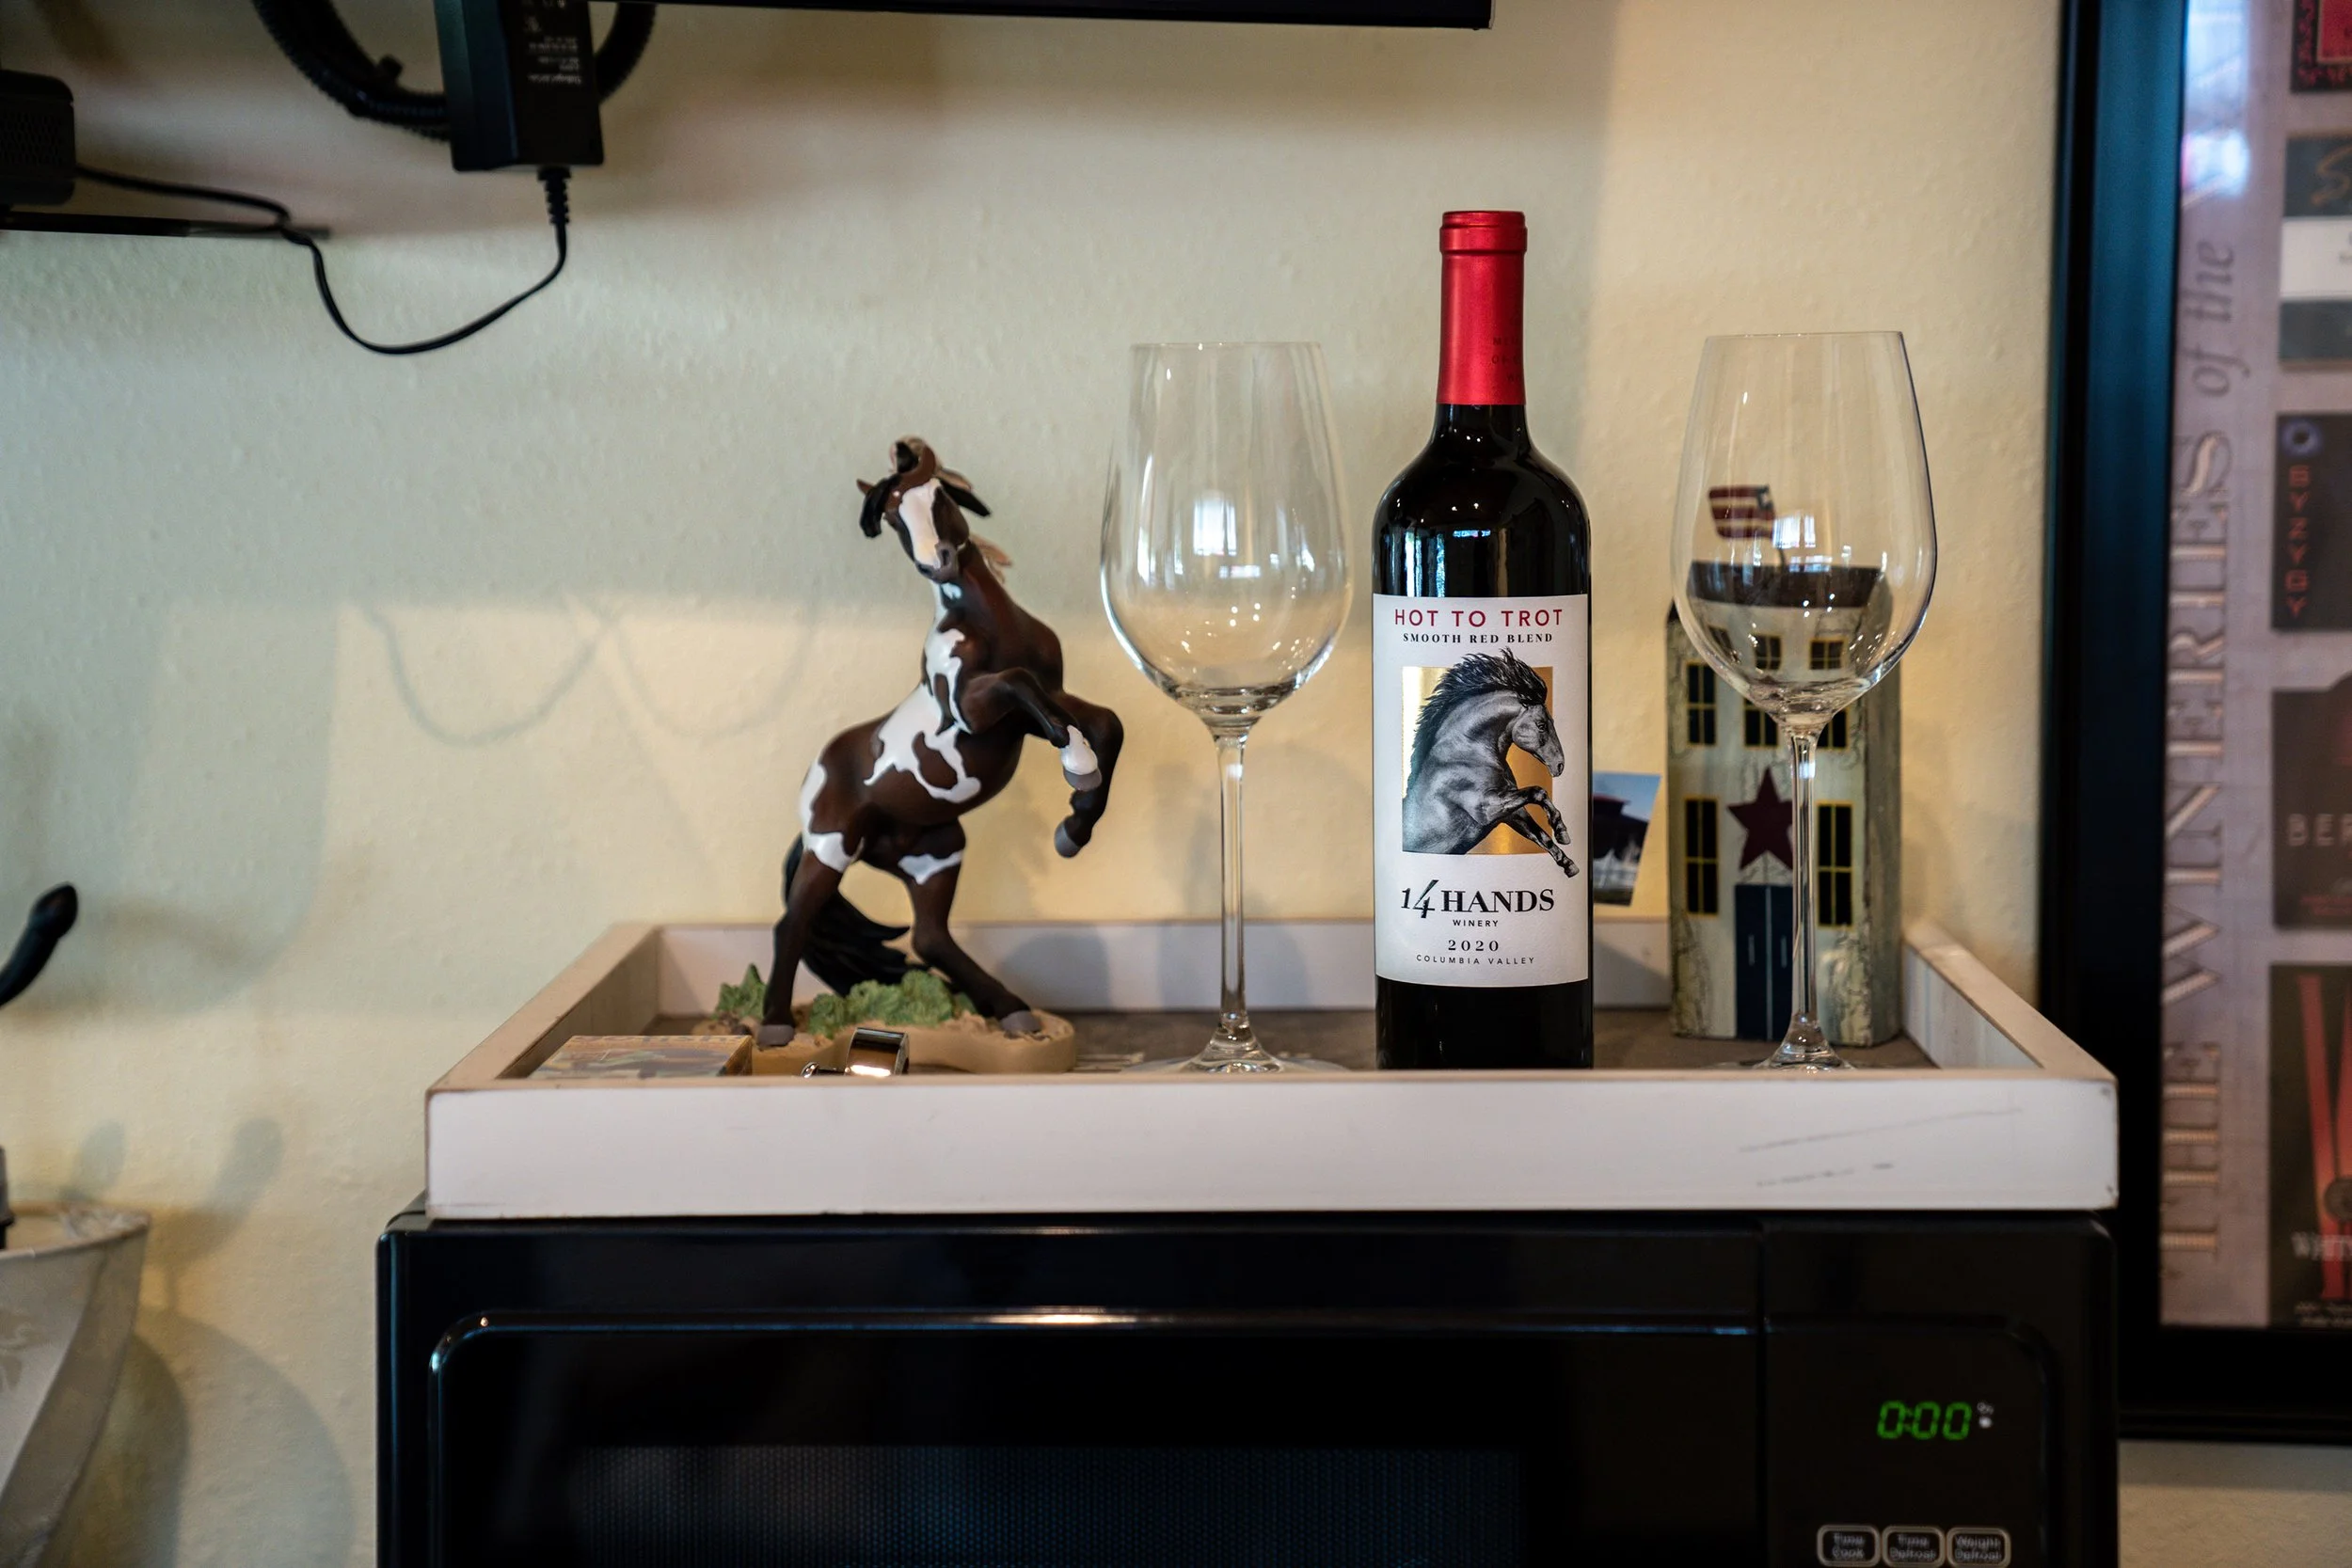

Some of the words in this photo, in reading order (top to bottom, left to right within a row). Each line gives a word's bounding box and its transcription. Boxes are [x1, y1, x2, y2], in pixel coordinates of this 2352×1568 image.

[2178, 239, 2234, 324] the
[2179, 344, 2251, 398] of
[1394, 609, 1438, 626] HOT
[1452, 610, 1486, 628] TO
[1501, 609, 1563, 627] TROT
[1403, 632, 1461, 643] SMOOTH
[1470, 634, 1500, 644] RED
[1507, 633, 1553, 644] BLEND
[2160, 429, 2232, 1003] WINERIES
[1401, 879, 1439, 919] 14
[1440, 888, 1554, 913] HANDS
[1453, 919, 1499, 927] WINERY
[1416, 954, 1480, 965] COLUMBIA
[1488, 957, 1535, 965] VALLEY
[1448, 939, 1499, 952] 2020
[1876, 1400, 1973, 1440] 0:00
